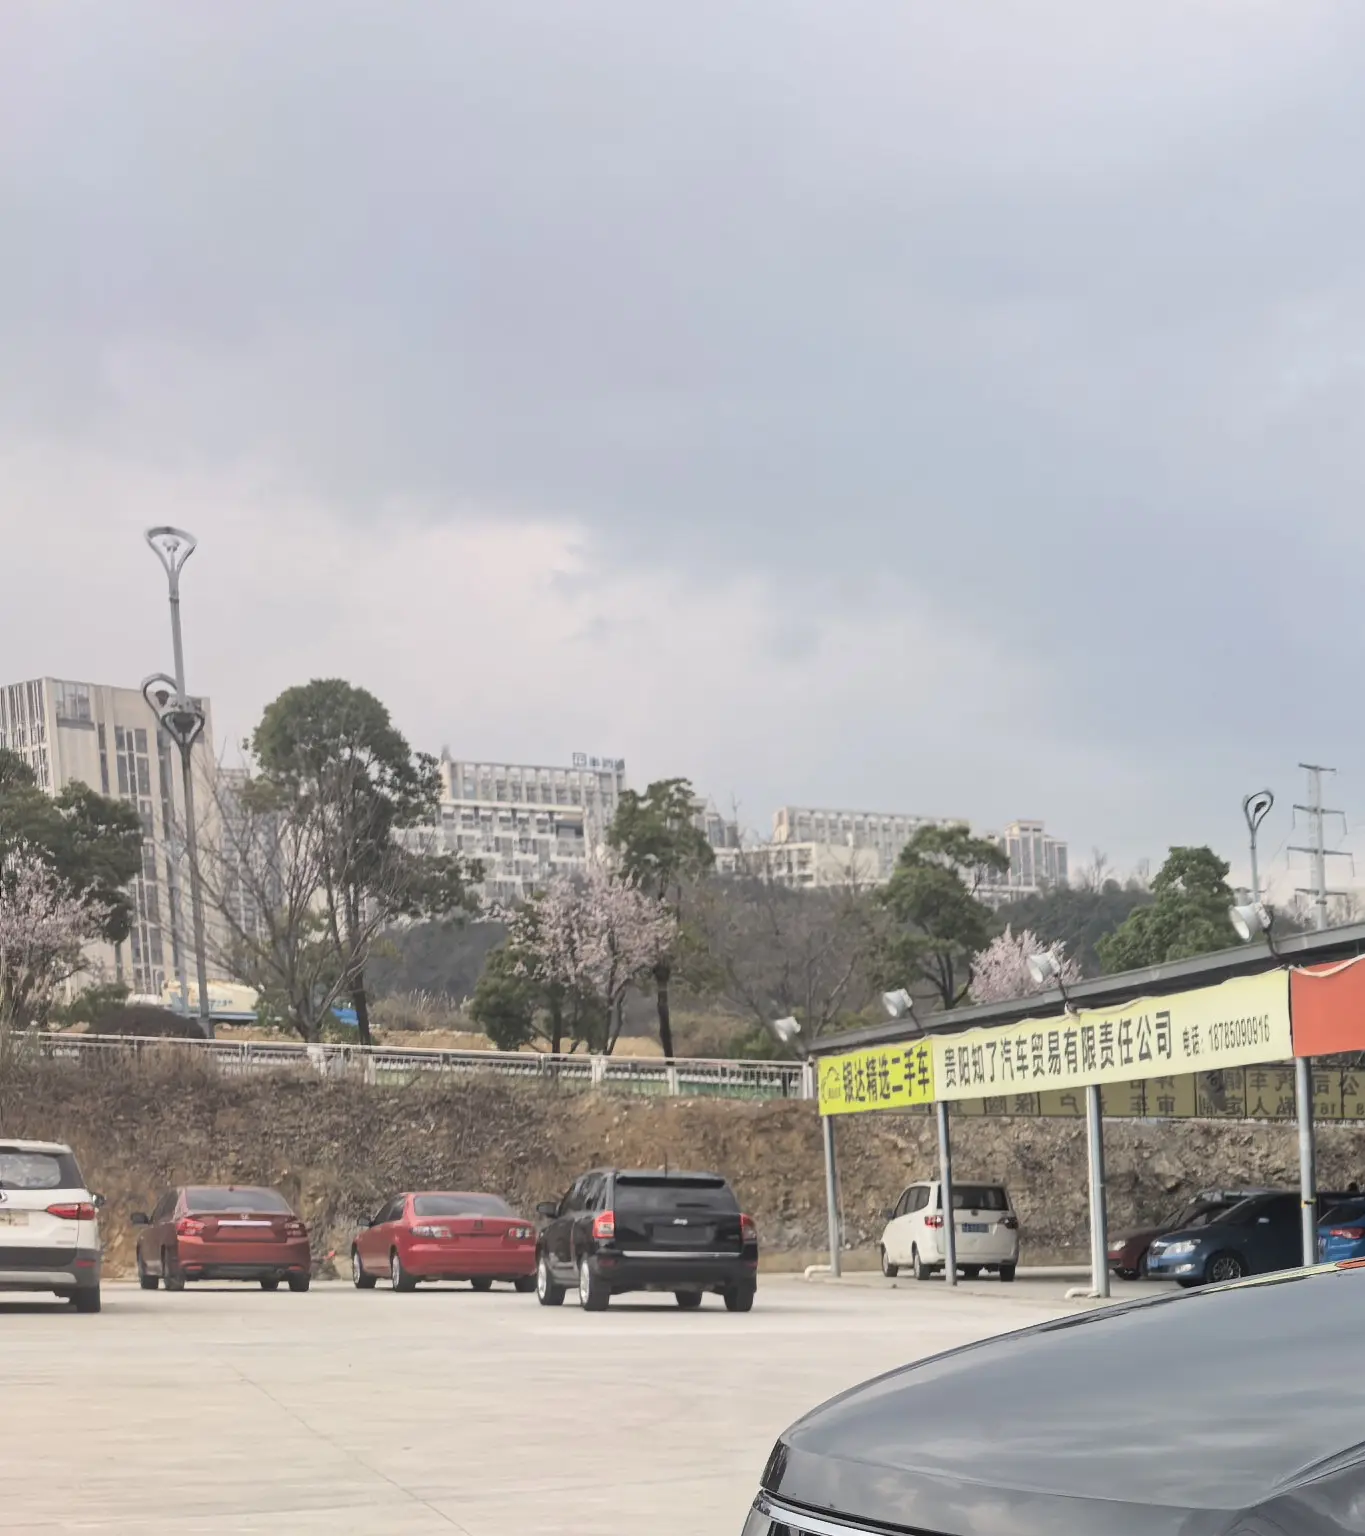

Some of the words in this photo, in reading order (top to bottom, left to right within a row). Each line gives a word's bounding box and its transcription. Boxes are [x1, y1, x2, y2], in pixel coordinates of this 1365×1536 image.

[944, 1010, 1172, 1088] 贵阳知了汽车贸易有限责任公司
